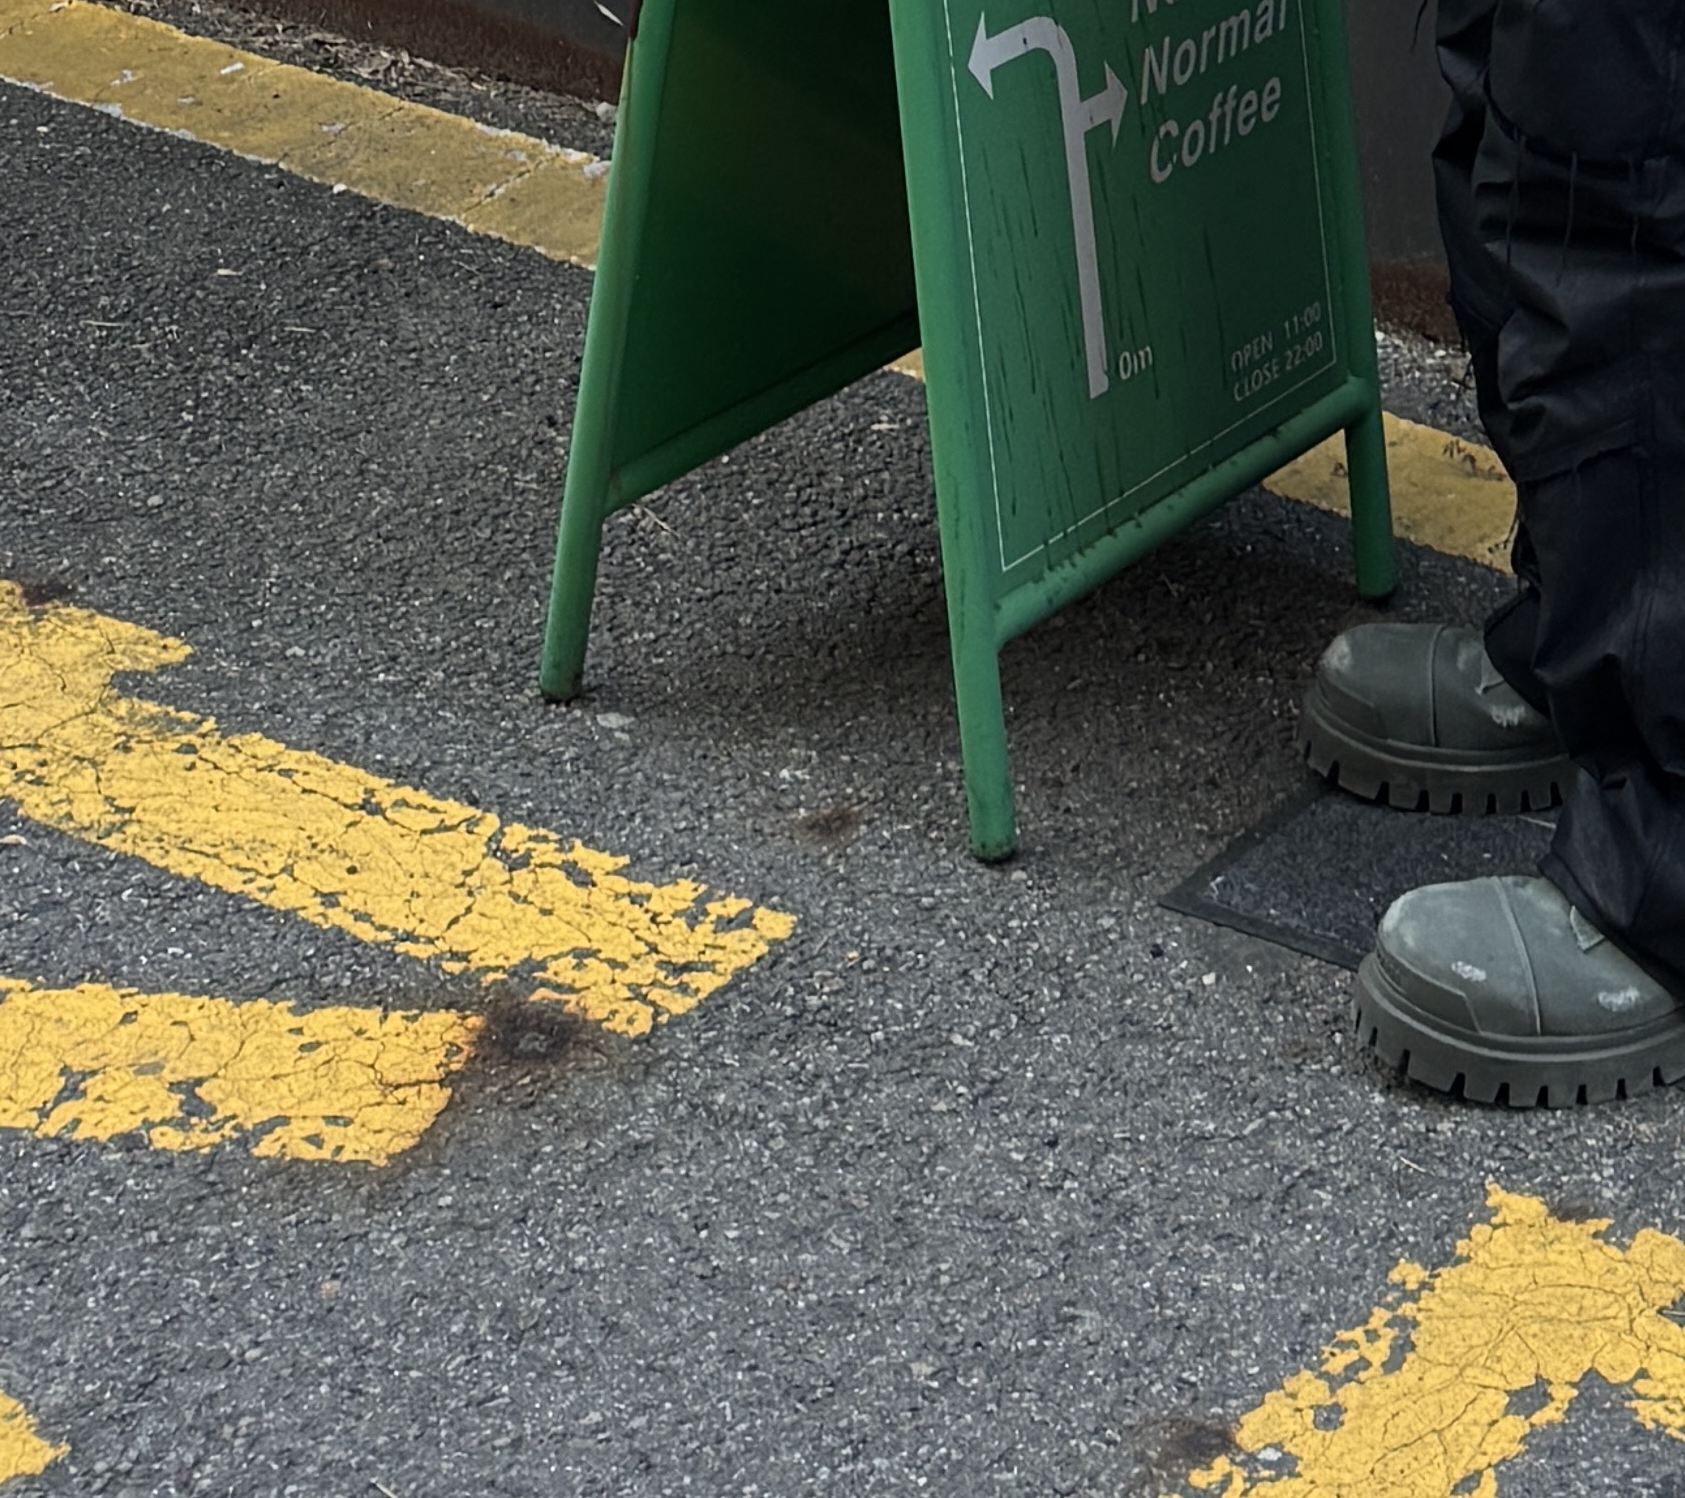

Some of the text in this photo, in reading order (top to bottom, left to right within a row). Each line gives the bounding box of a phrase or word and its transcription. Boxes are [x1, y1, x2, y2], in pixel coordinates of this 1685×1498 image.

[1149, 76, 1283, 184] Coffee
[1231, 301, 1322, 373] OPEN 11:00
[1233, 330, 1324, 402] CLOSE 22:00
